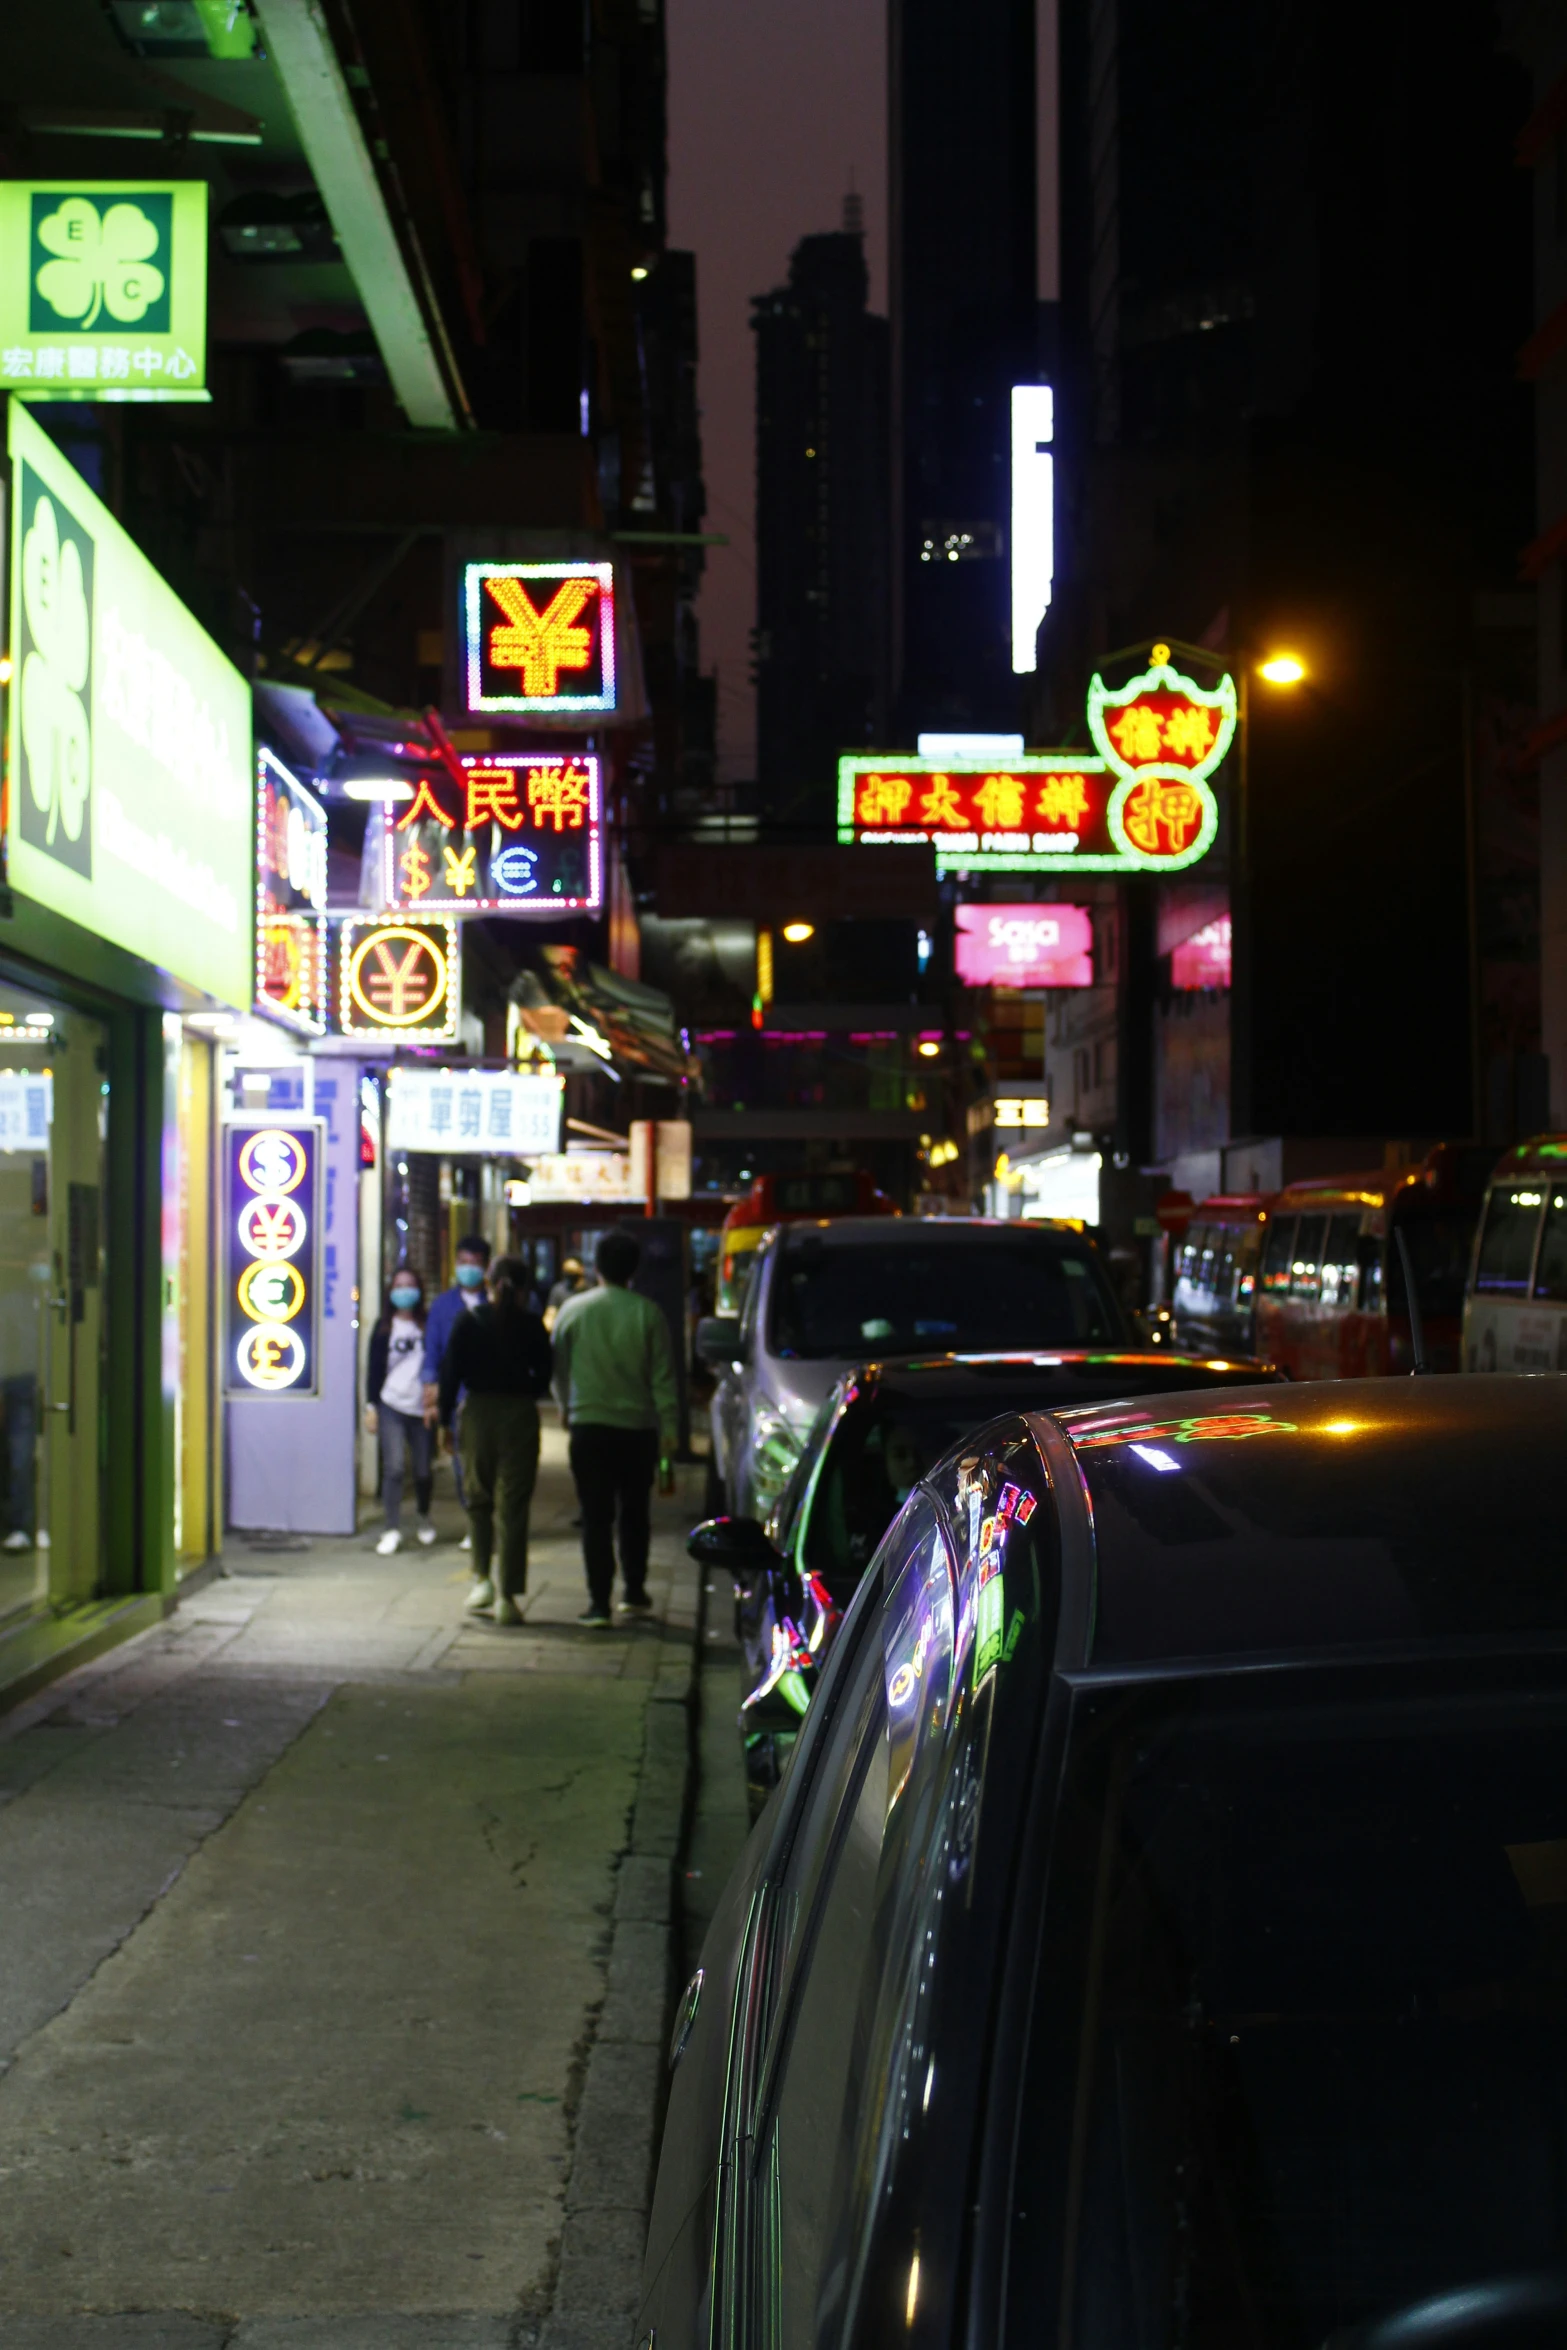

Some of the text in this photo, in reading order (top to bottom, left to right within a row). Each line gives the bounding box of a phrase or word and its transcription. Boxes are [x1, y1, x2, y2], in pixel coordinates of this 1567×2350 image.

[69, 220, 84, 240] E
[123, 280, 141, 299] C
[2, 346, 196, 378] 宏康醫務中心
[486, 577, 599, 697] ¥
[397, 767, 589, 831] 人民幣
[1125, 778, 1202, 851] 押
